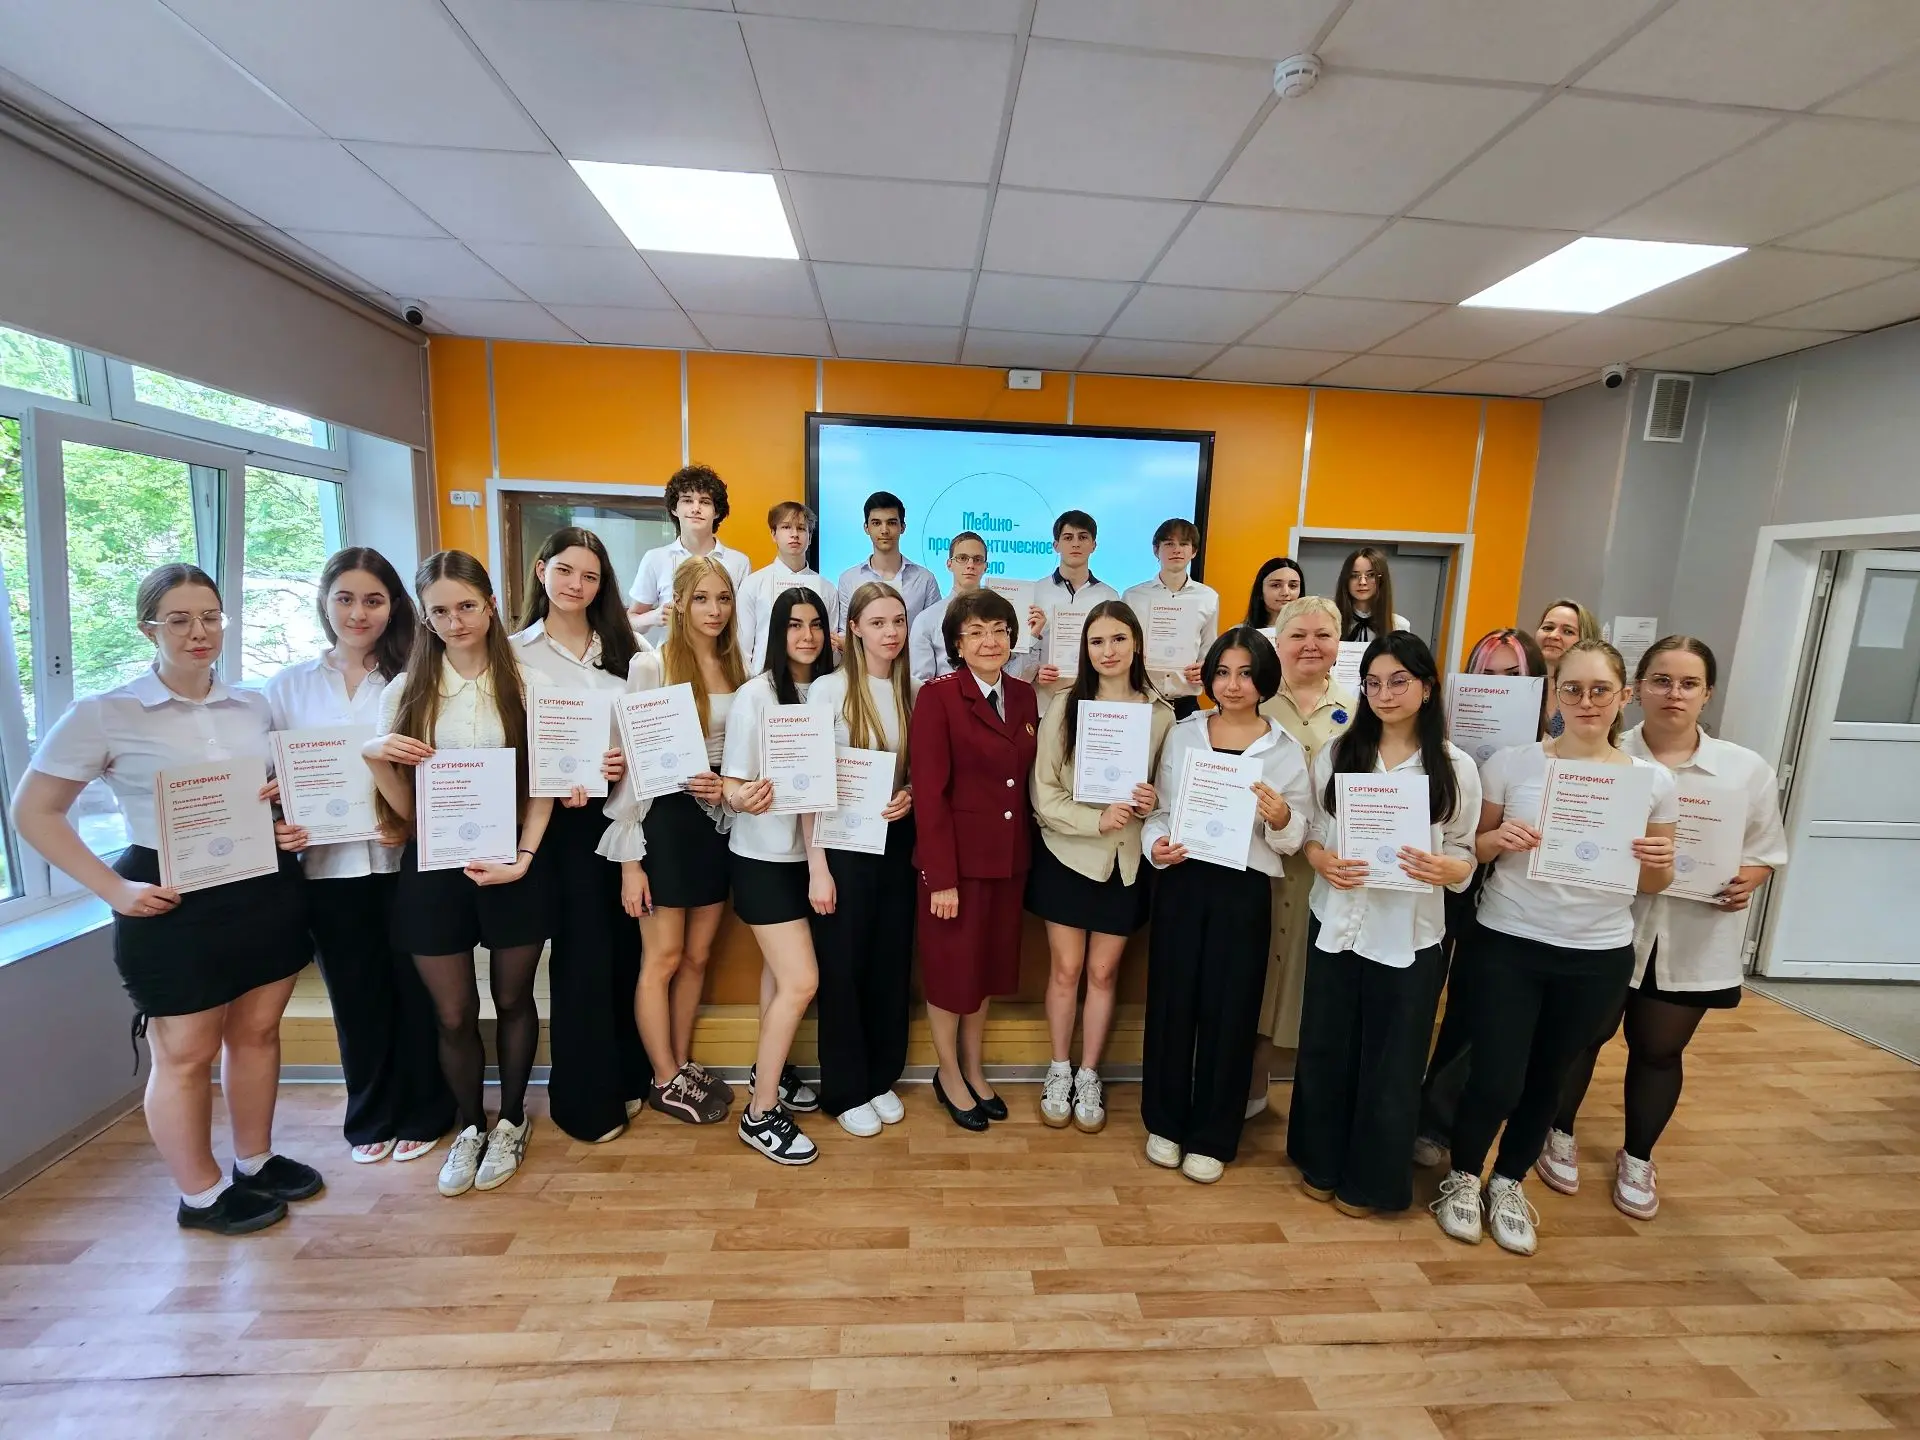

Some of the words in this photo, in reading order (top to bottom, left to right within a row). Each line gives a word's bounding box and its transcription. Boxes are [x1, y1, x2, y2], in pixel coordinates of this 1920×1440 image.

[962, 511, 1020, 532] Медико-
[928, 537, 1053, 556] проктическое
[986, 561, 1005, 574] ело
[1459, 686, 1510, 695] СЕРТИФИКАТ
[538, 698, 584, 707] СЕРТИФИКАТ
[626, 698, 670, 712] СЕРТИФИКАТ
[1088, 712, 1128, 720] СЕРТИФИКАТ
[288, 739, 346, 750] СЕРТИФИКАТ
[430, 762, 485, 770] СЕРТИФИКАТ
[836, 757, 873, 767] ЕРТИФИКАТ
[1195, 761, 1238, 774] СЕРТИФИКАТ
[169, 773, 231, 789] СЕРТИФИКАТ
[1558, 773, 1616, 785] СЕРТИФИКАТ
[1348, 786, 1399, 794] СЕРТИФИКАТ
[1678, 797, 1712, 806] ФИКАТ
